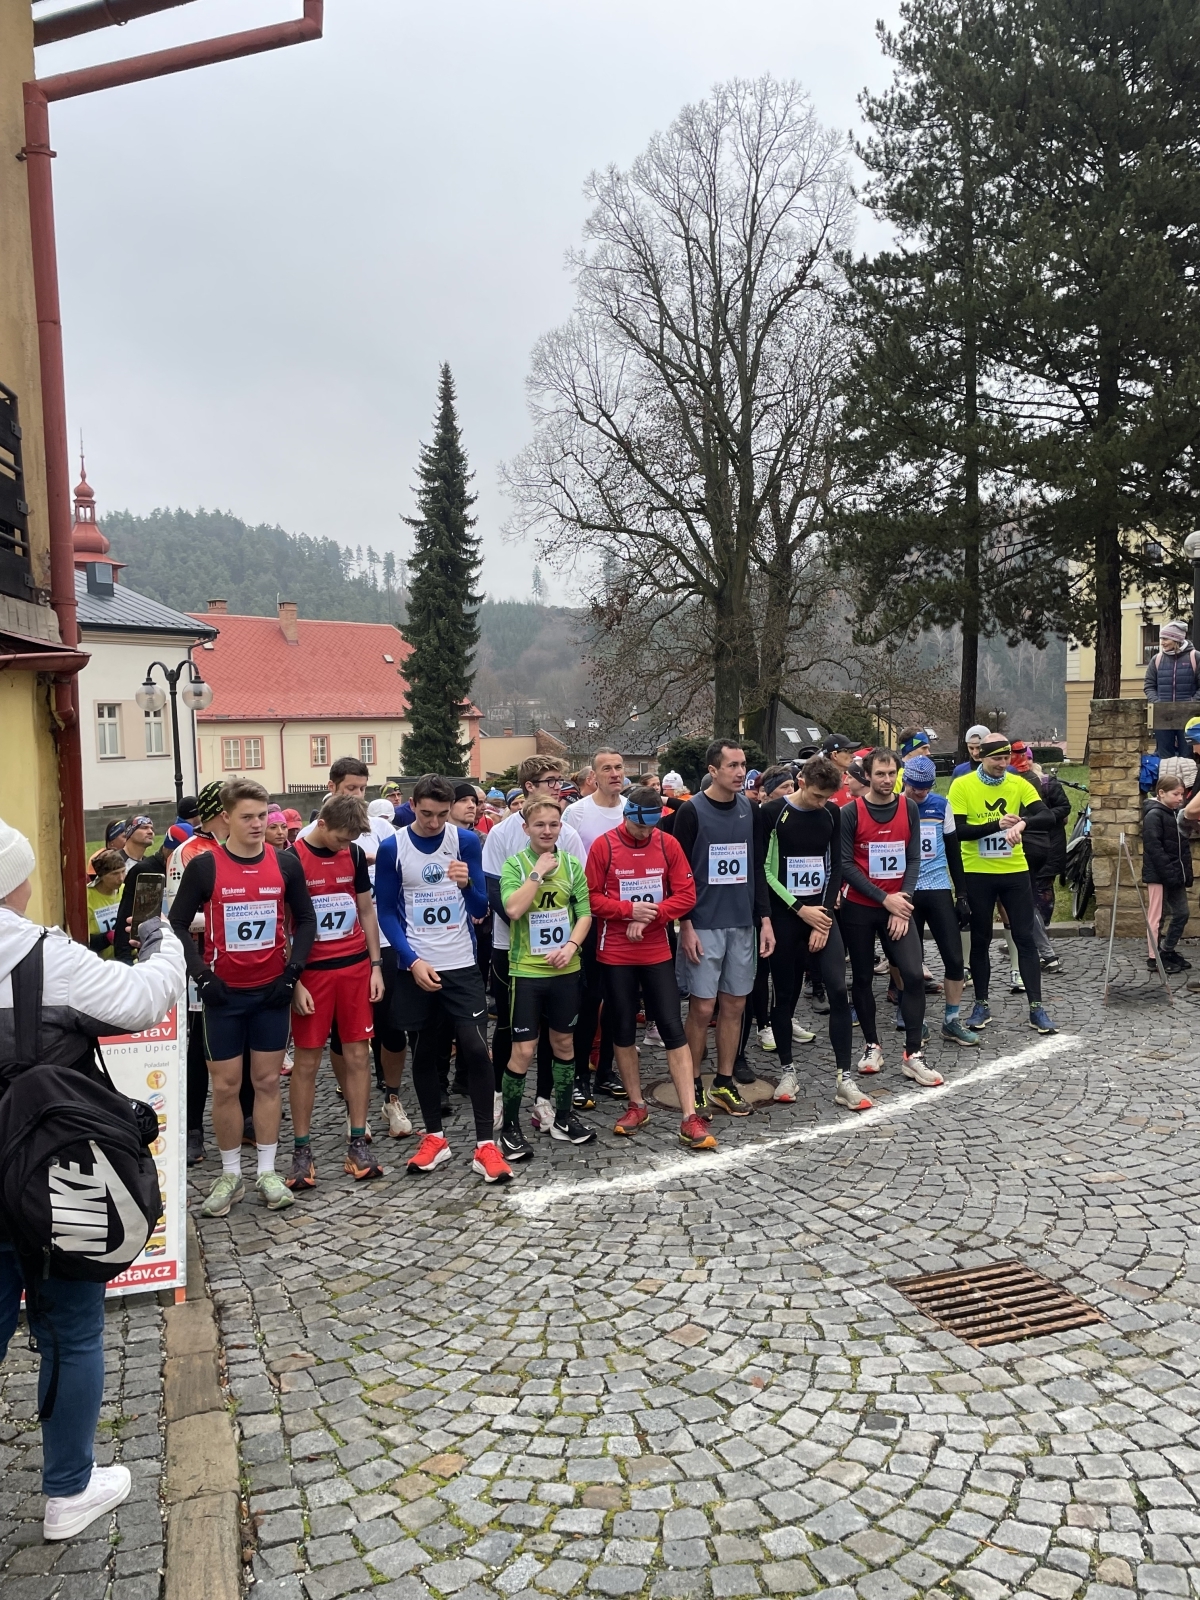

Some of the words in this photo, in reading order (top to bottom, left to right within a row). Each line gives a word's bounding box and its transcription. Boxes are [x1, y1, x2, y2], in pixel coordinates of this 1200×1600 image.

[984, 837, 1007, 850] 112
[718, 859, 740, 876] 80
[880, 856, 898, 871] 12
[792, 871, 821, 887] 146
[226, 904, 249, 912] ZIMNÍ
[423, 906, 451, 925] 60
[321, 911, 346, 930] 47
[238, 920, 266, 941] 67
[540, 926, 564, 945] 50
[146, 1043, 177, 1054] Úpice
[144, 1061, 170, 1069] Pořadatel
[48, 1160, 109, 1252] NIKE
